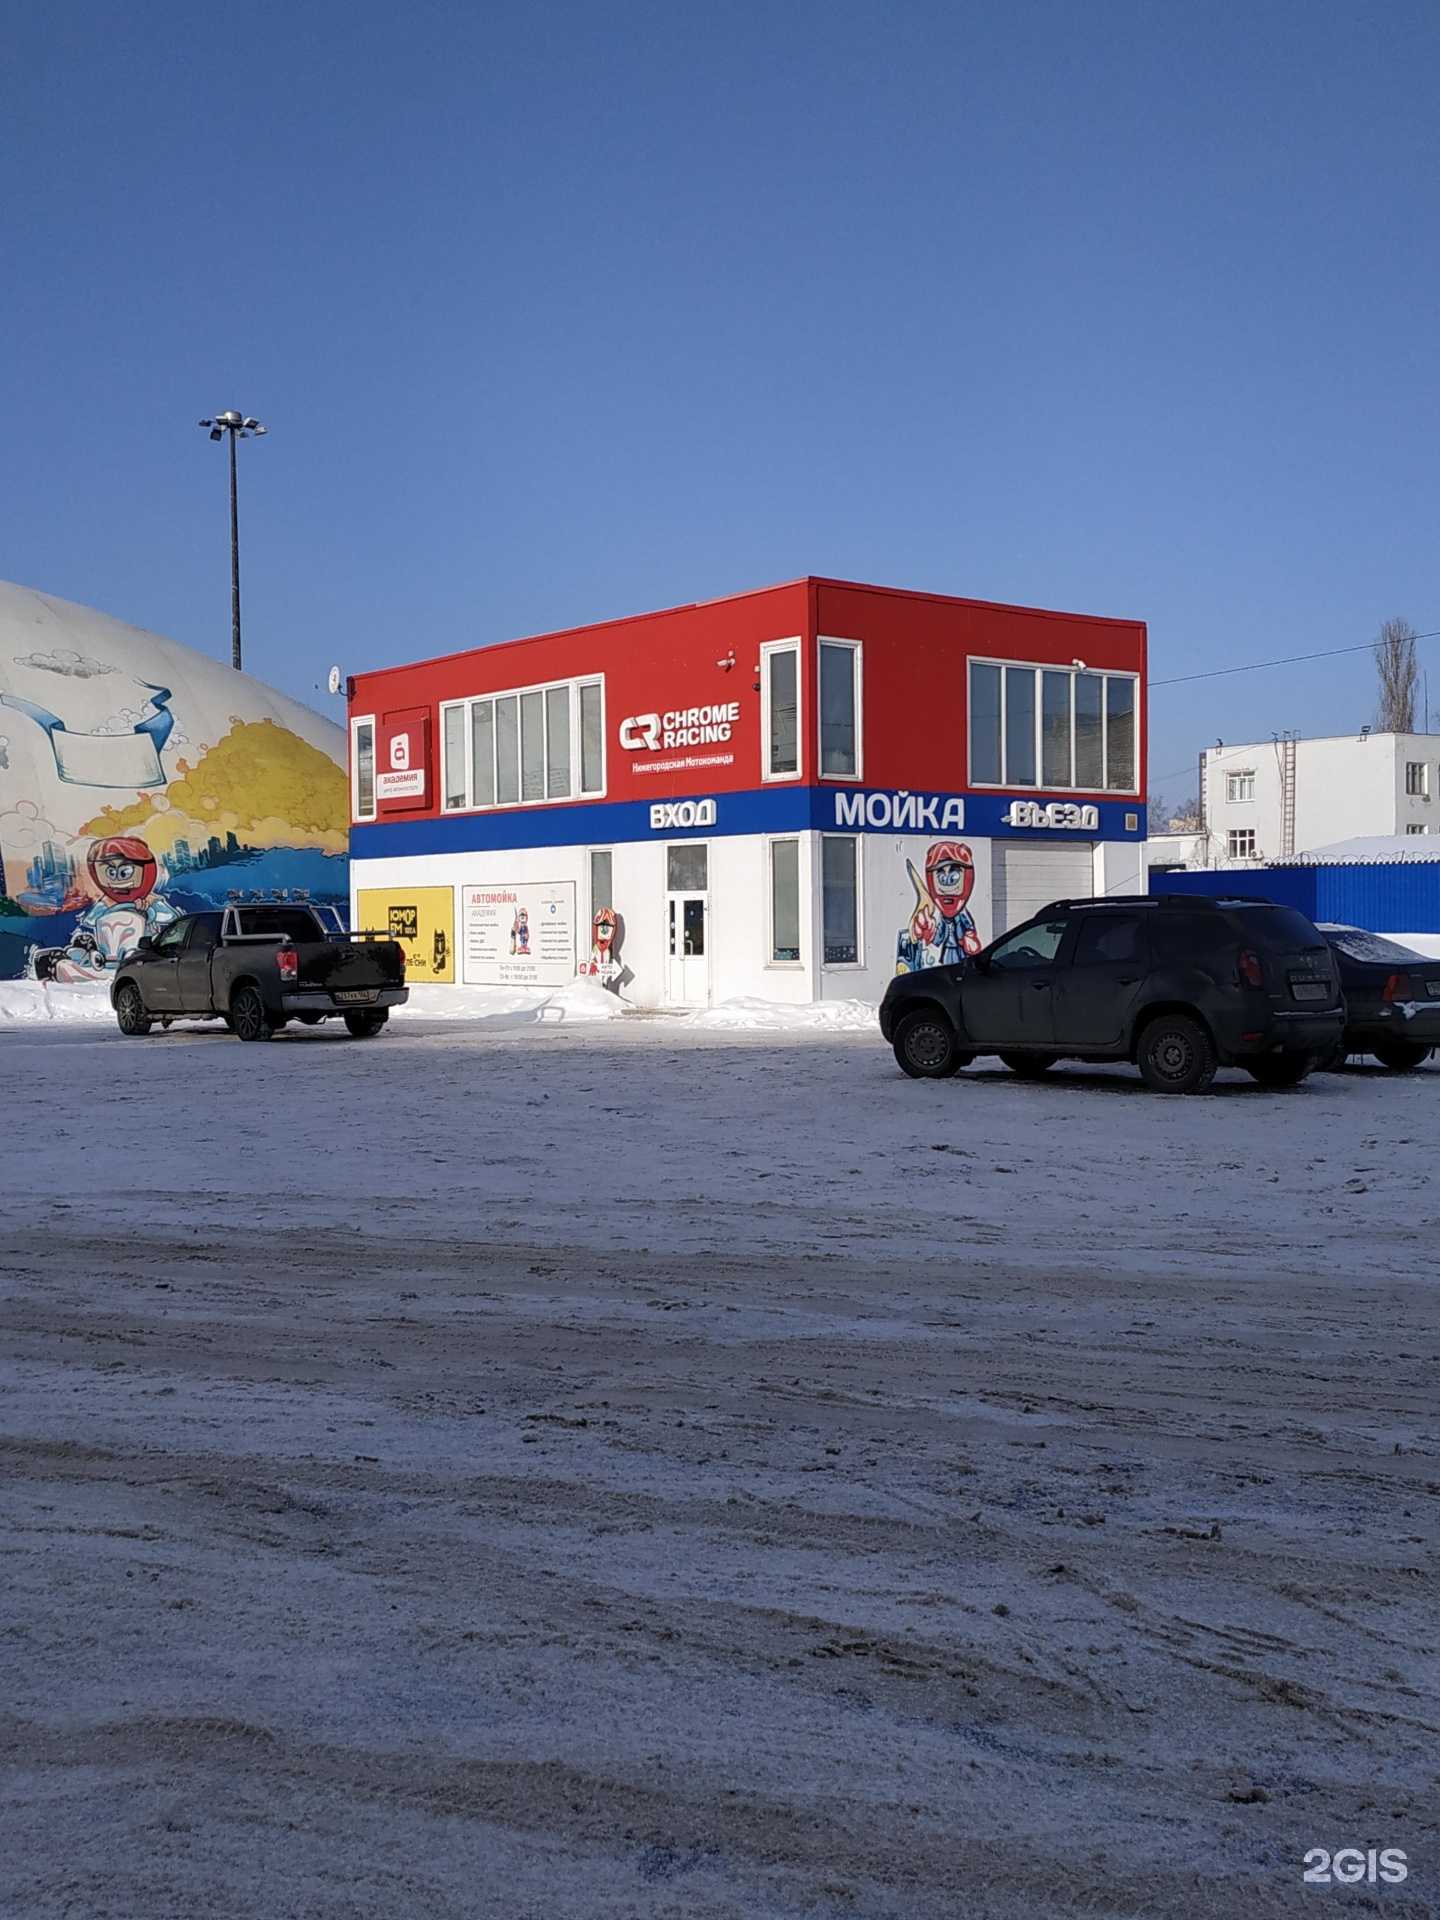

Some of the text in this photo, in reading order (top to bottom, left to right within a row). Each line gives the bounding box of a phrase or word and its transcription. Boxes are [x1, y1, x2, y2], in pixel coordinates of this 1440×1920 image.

[662, 702, 740, 730] CHROME
[619, 713, 662, 750] CR
[663, 723, 732, 749] RACING
[632, 761, 685, 773] Нижегородская
[649, 798, 717, 829] ВХОД
[835, 790, 965, 830] МОЙКА
[1010, 800, 1099, 830] ВЪЕЗД
[471, 890, 518, 904] АВТОМОЙКА
[389, 909, 416, 926] ЮМОР
